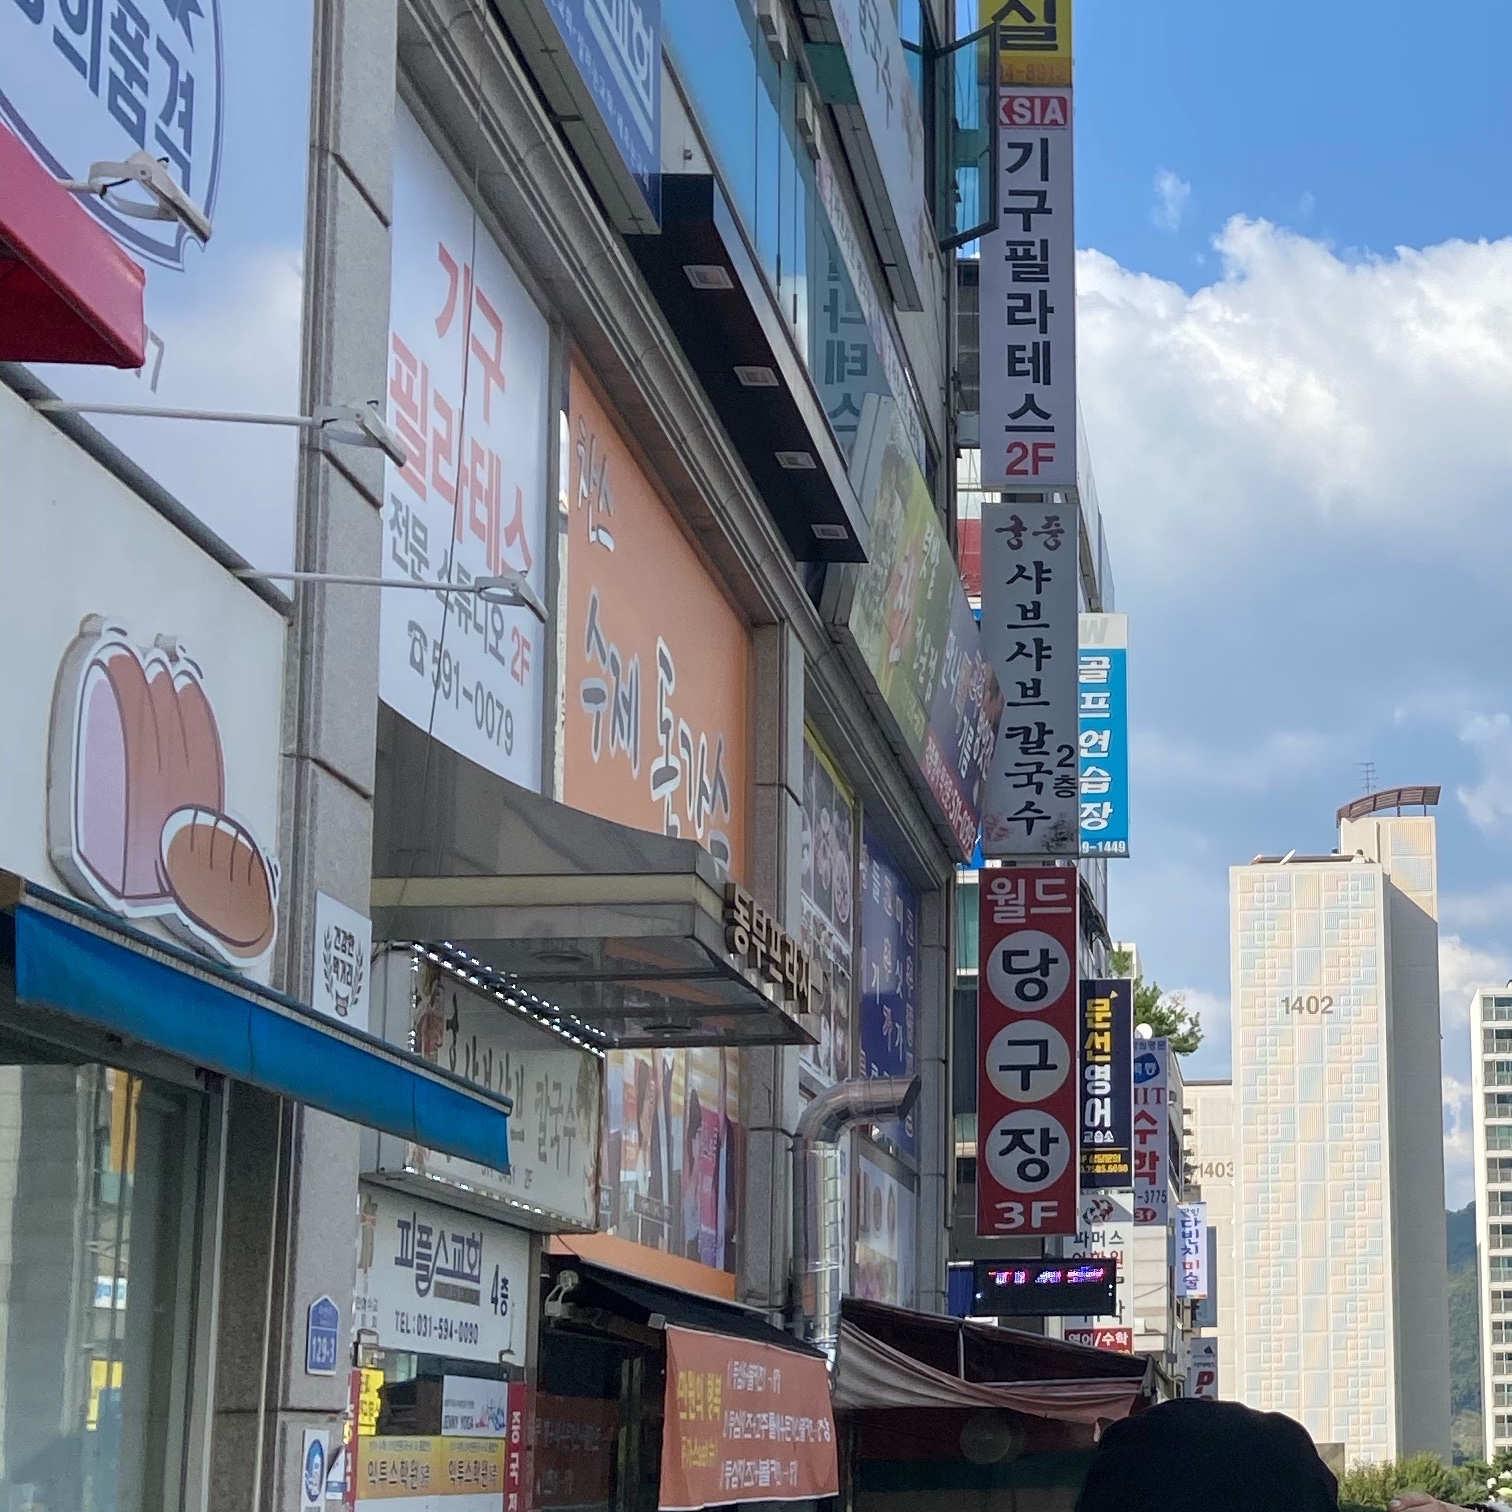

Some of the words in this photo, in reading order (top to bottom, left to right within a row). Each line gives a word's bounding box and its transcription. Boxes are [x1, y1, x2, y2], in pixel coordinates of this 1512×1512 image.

[12, 0, 194, 197] 의품격
[1003, 136, 1056, 434] 기구필라테스
[436, 241, 507, 425] 기구
[390, 330, 534, 573] 필라테스
[1006, 440, 1056, 476] 2F
[388, 492, 430, 584] 전문
[995, 513, 1066, 552] 궁중
[510, 624, 532, 688] 2F
[431, 638, 515, 758] 591-0079
[1005, 560, 1054, 837] 샤브샤브칼국수
[1053, 744, 1078, 799] 2층
[1078, 655, 1113, 832] 골프연습장
[1080, 840, 1126, 854] 9-1449
[987, 877, 1073, 924] 월드
[1281, 995, 1334, 1015] 1402
[998, 947, 1060, 1183] 당구장
[1082, 997, 1115, 1130] 문선영어
[1134, 1109, 1160, 1186] 수학
[1200, 1161, 1234, 1178] 1403
[994, 1201, 1059, 1229] 3F
[1134, 1190, 1168, 1204] -3775
[1073, 1228, 1125, 1249] 파머스
[1068, 1330, 1130, 1347] 영어/수학
